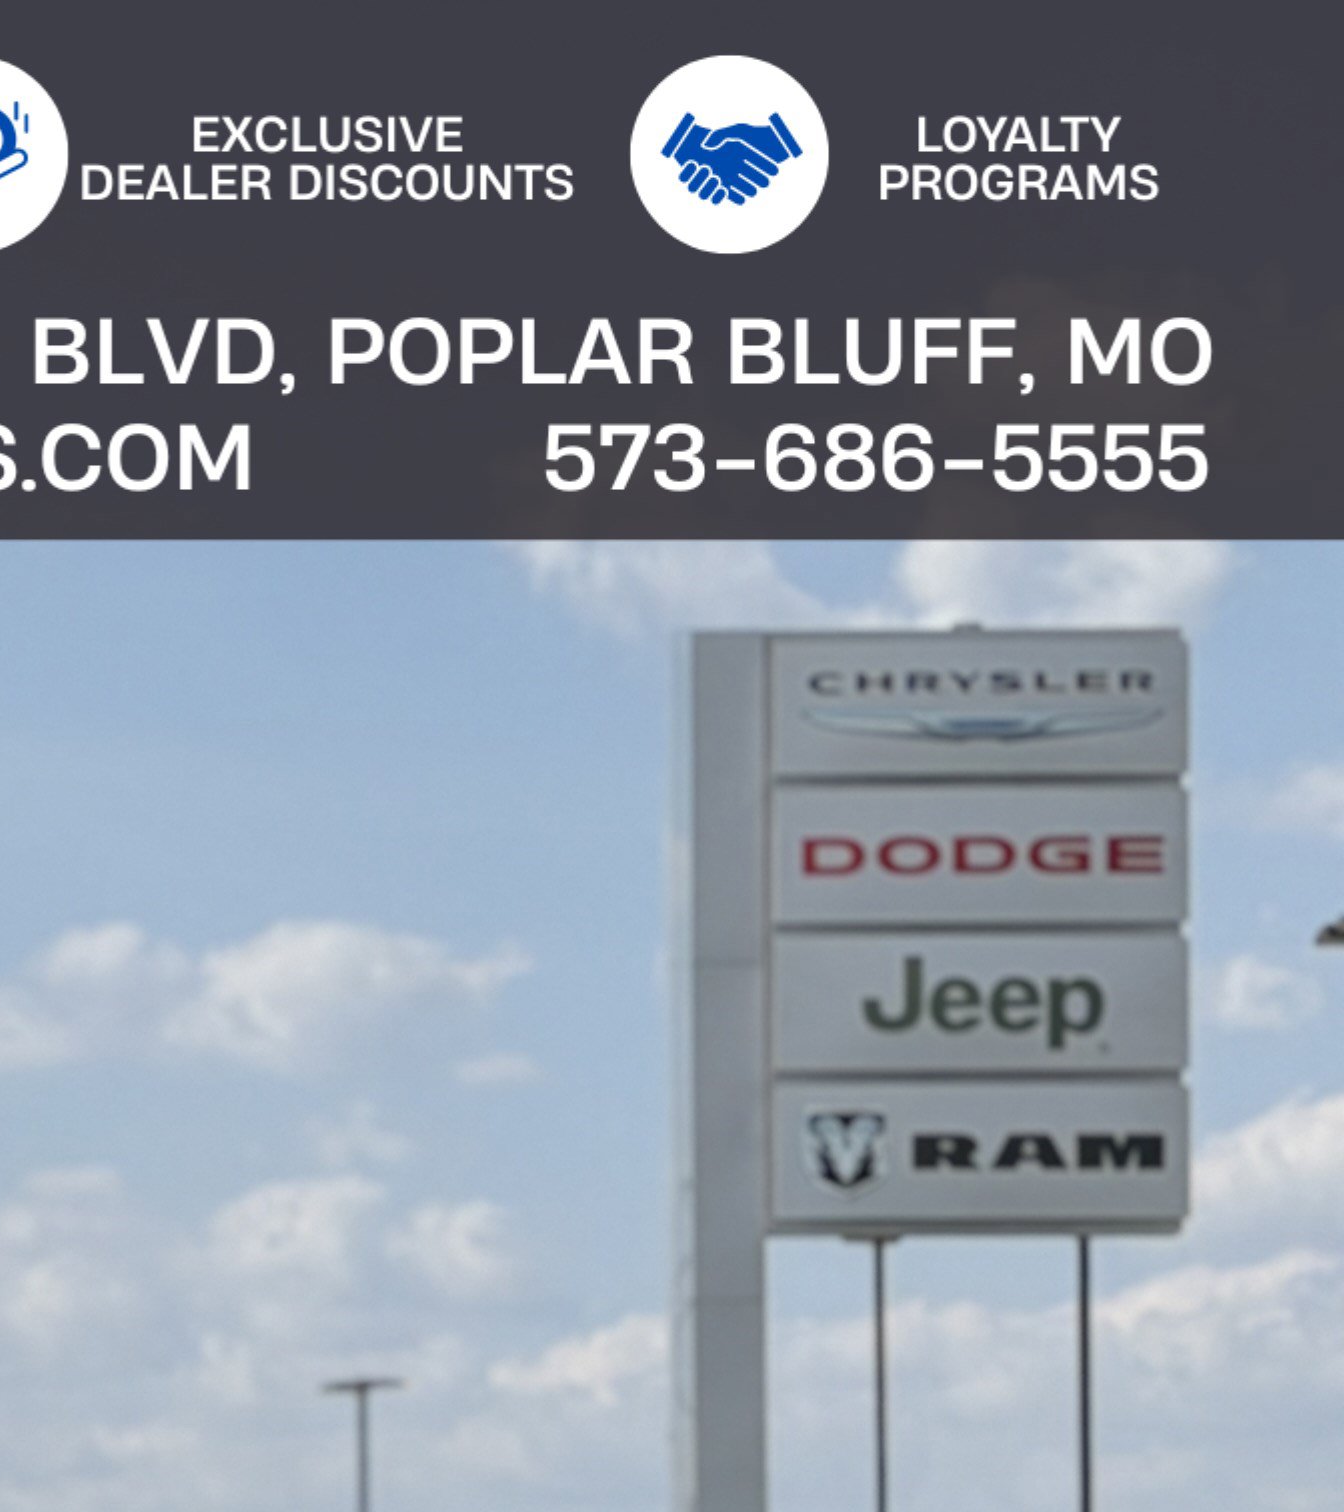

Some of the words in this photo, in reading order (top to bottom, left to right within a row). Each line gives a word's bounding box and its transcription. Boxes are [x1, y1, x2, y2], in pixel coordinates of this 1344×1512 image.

[808, 669, 1154, 694] CHRYSLER
[801, 836, 1165, 876] DODGE
[863, 956, 1105, 1052] Jeep
[912, 1134, 1165, 1170] RAM
